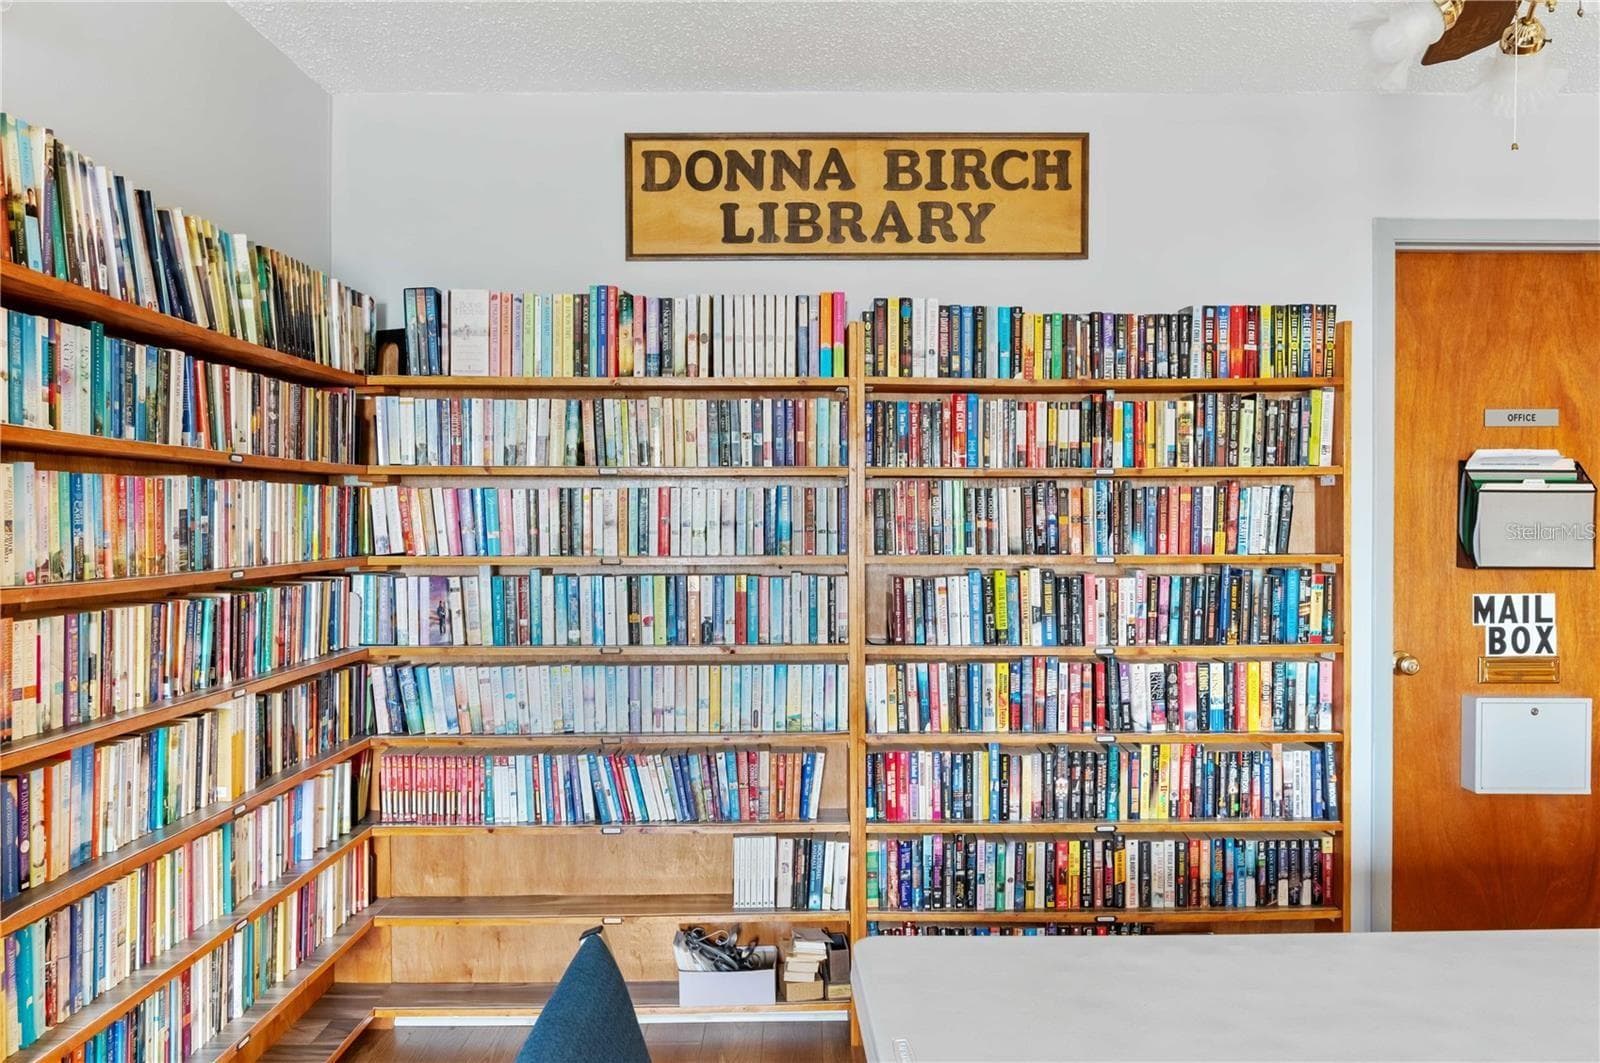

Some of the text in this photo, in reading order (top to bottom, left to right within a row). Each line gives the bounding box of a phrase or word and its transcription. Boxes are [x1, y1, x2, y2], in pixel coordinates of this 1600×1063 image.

[641, 147, 1072, 192] DONNA BIRCH
[720, 200, 996, 244] LIBRARY
[1206, 320, 1214, 343] LEE CHILD
[1220, 320, 1228, 328] LEE
[1302, 318, 1311, 327] LEE
[1326, 319, 1334, 327] LEE
[940, 318, 949, 357] DAVID BALDACCI
[1220, 330, 1228, 343] CHILD
[1248, 321, 1256, 344] LEE CHILD
[1302, 328, 1311, 341] CHILD
[1326, 328, 1334, 341] CHILD
[1508, 413, 1536, 422] OFFICE
[1473, 595, 1553, 623] MAIL
[1488, 625, 1553, 655] BOX
